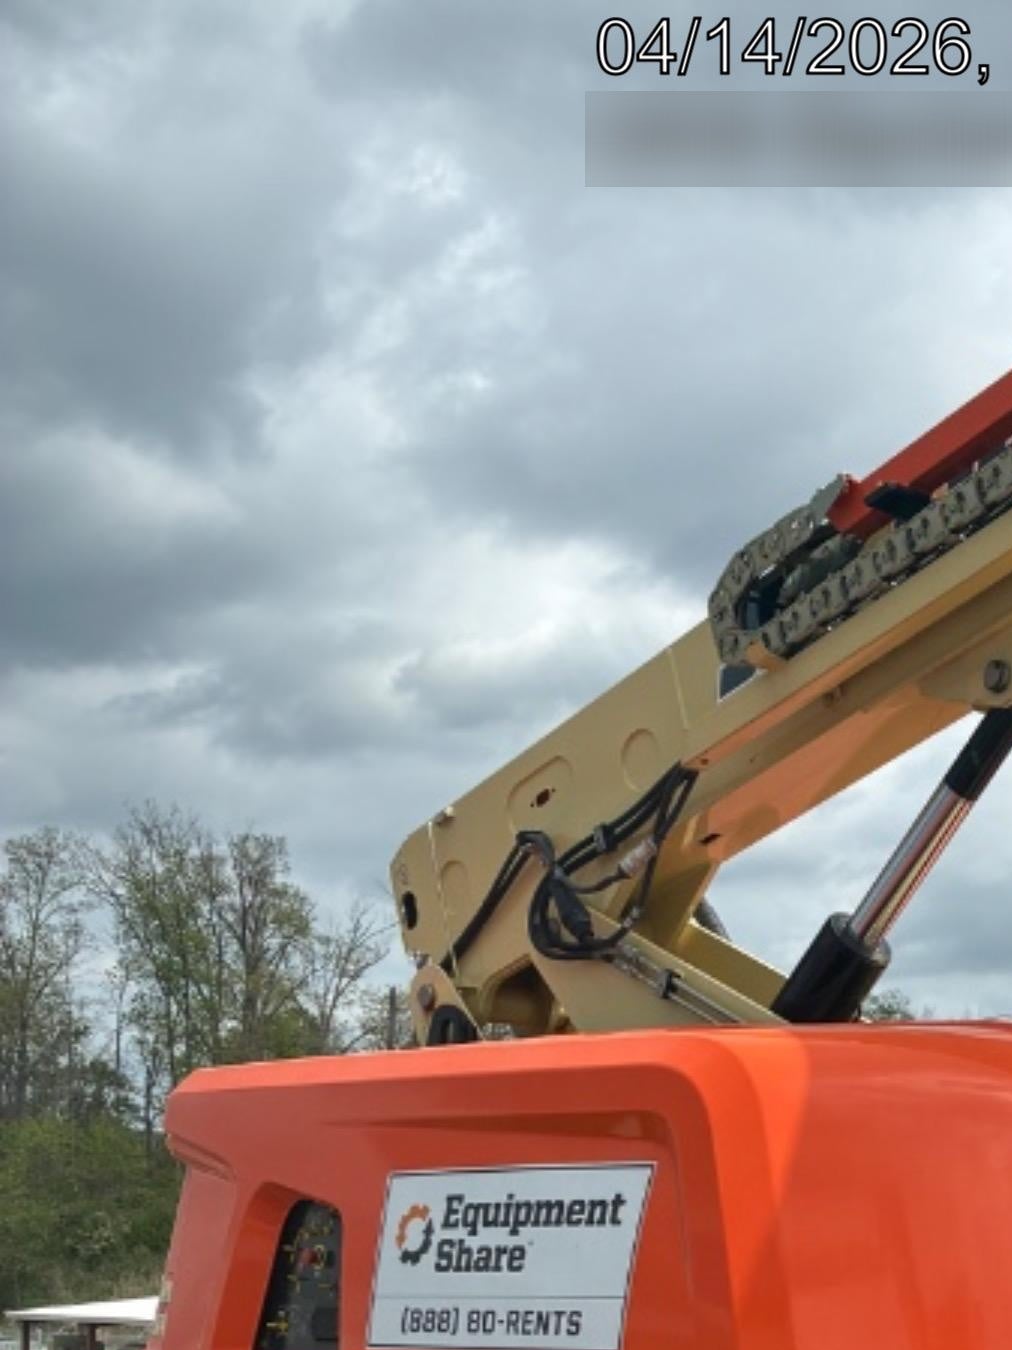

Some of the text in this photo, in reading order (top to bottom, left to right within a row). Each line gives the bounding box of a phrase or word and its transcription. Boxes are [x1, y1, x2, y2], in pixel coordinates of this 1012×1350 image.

[441, 1193, 626, 1236] Equipment
[434, 1239, 526, 1273] Share
[401, 1306, 583, 1336] (888) 80-RENTS
